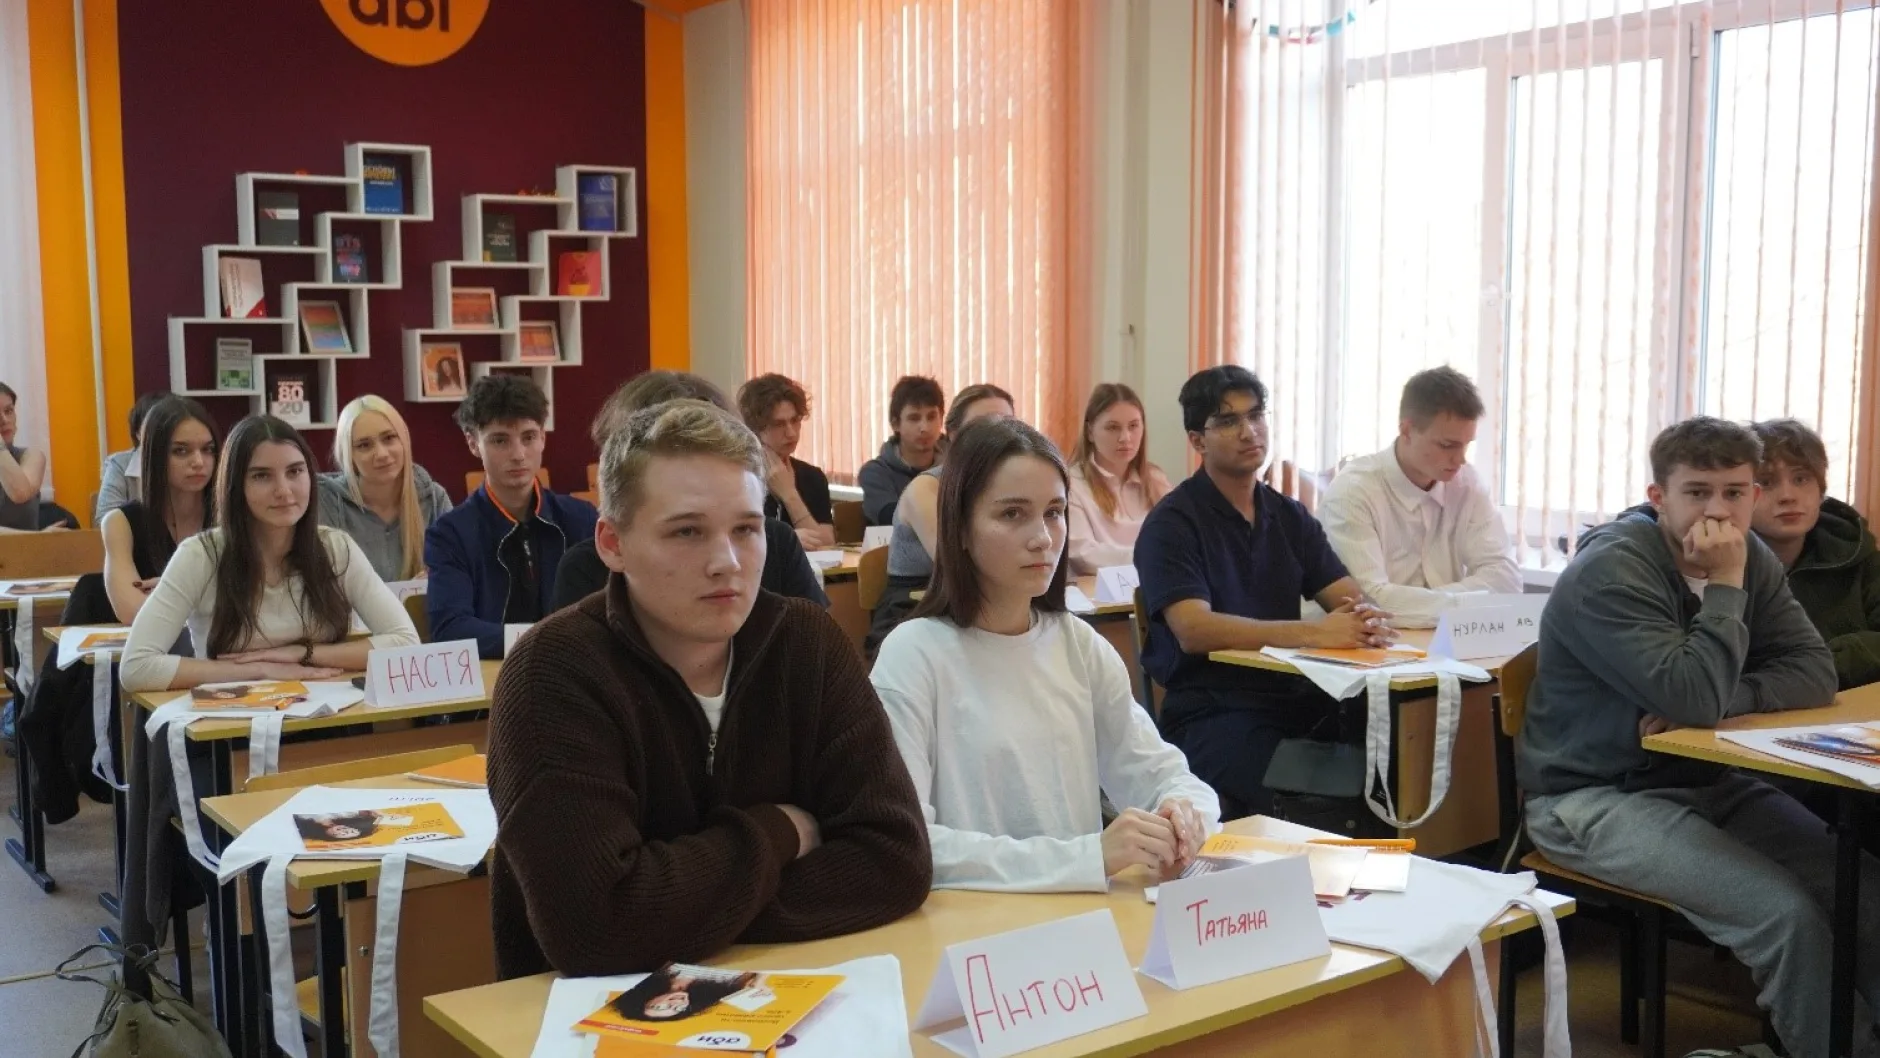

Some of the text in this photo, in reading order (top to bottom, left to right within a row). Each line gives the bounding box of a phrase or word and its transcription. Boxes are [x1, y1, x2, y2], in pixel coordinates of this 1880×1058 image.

[278, 385, 304, 402] 80
[1453, 621, 1504, 637] НУРЛАН
[387, 649, 474, 694] НАСТЯ
